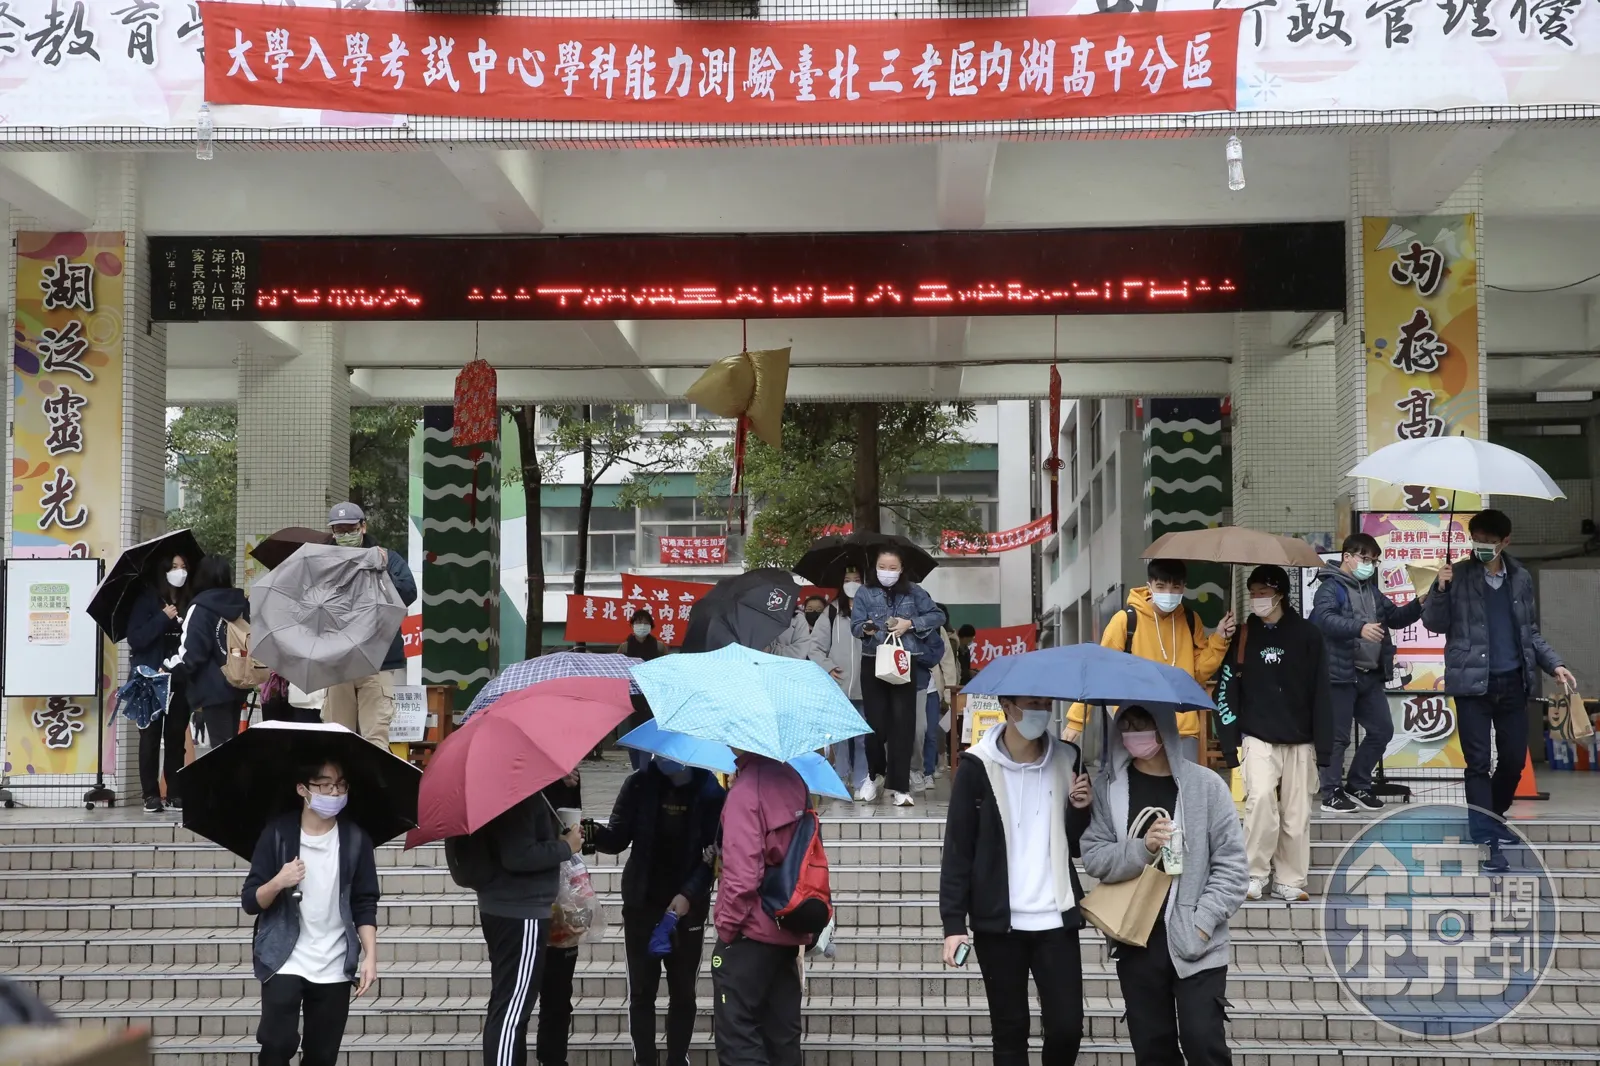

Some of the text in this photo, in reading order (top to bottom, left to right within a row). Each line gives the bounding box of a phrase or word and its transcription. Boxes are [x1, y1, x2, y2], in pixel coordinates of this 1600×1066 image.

[226, 27, 1213, 103] 大學入學考試中心學科能力測驗臺北三考區內湖高中分區
[211, 248, 226, 310] 第十八屆
[231, 248, 246, 311] 內湖高中
[1218, 664, 1237, 725] RIPNDIP
